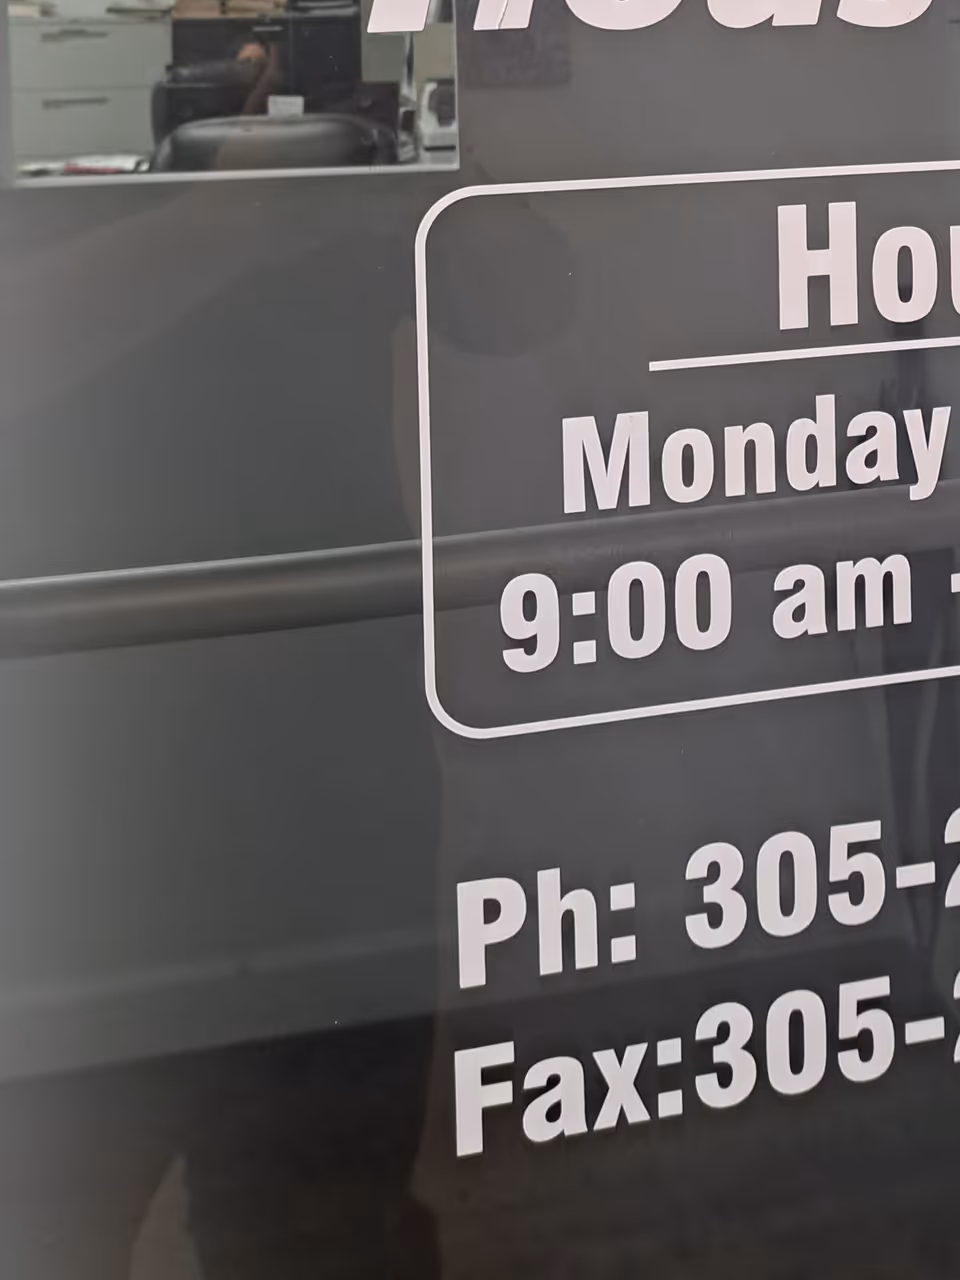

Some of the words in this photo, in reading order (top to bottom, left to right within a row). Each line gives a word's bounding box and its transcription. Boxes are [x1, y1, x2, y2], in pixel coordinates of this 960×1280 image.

[562, 393, 953, 514] Monday
[500, 553, 732, 673] 9:00
[772, 553, 912, 639] am
[456, 867, 637, 989] Ph:
